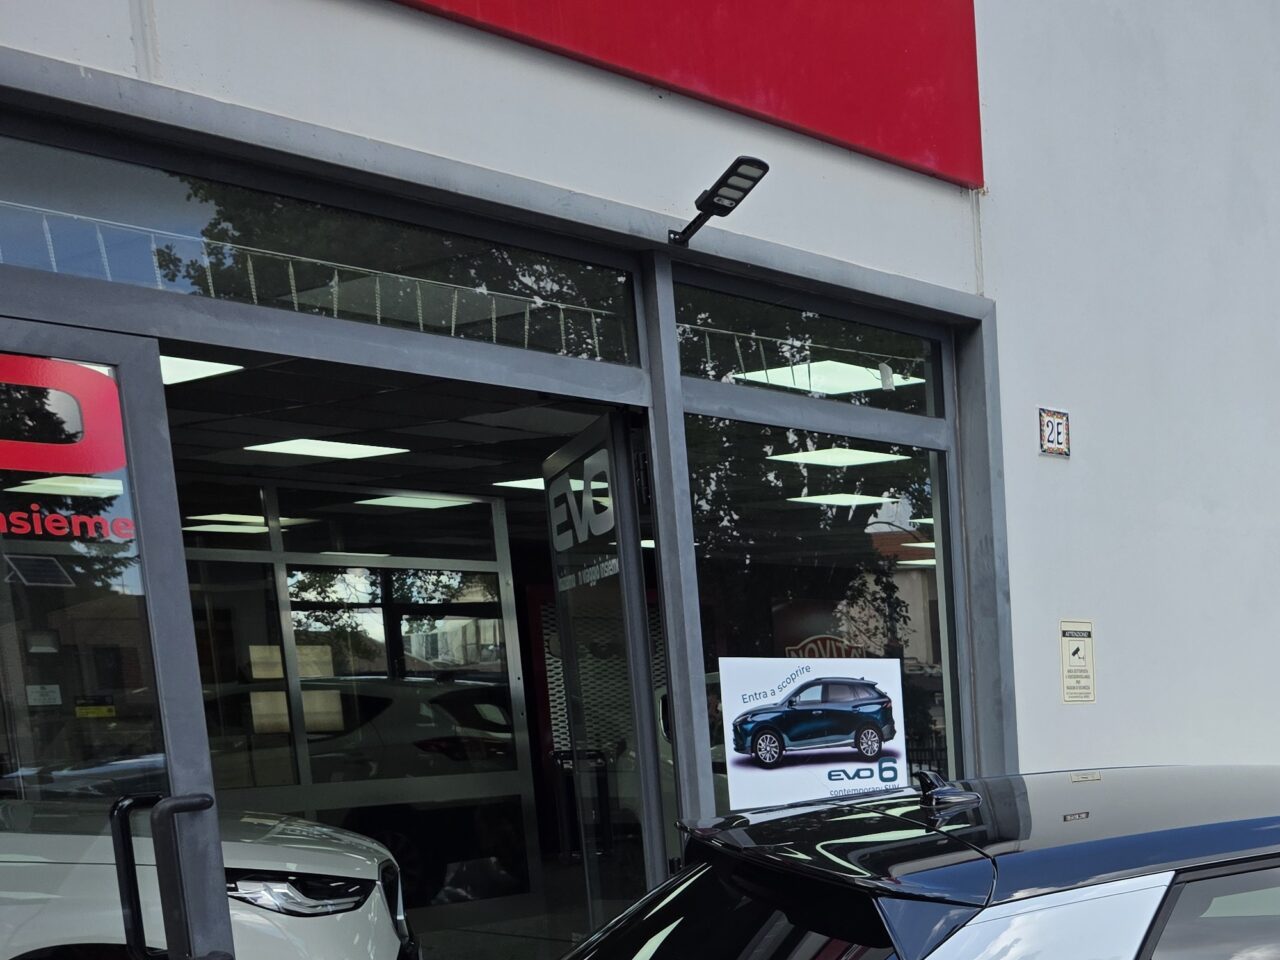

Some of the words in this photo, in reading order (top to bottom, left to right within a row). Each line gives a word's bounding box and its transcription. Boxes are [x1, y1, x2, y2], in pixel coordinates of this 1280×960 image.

[1046, 419, 1063, 445] 2E
[550, 448, 615, 552] EVO
[741, 690, 768, 704] Entra
[770, 688, 776, 697] a
[777, 665, 811, 693] scoprire
[827, 767, 875, 781] EVO
[878, 756, 898, 783] 6
